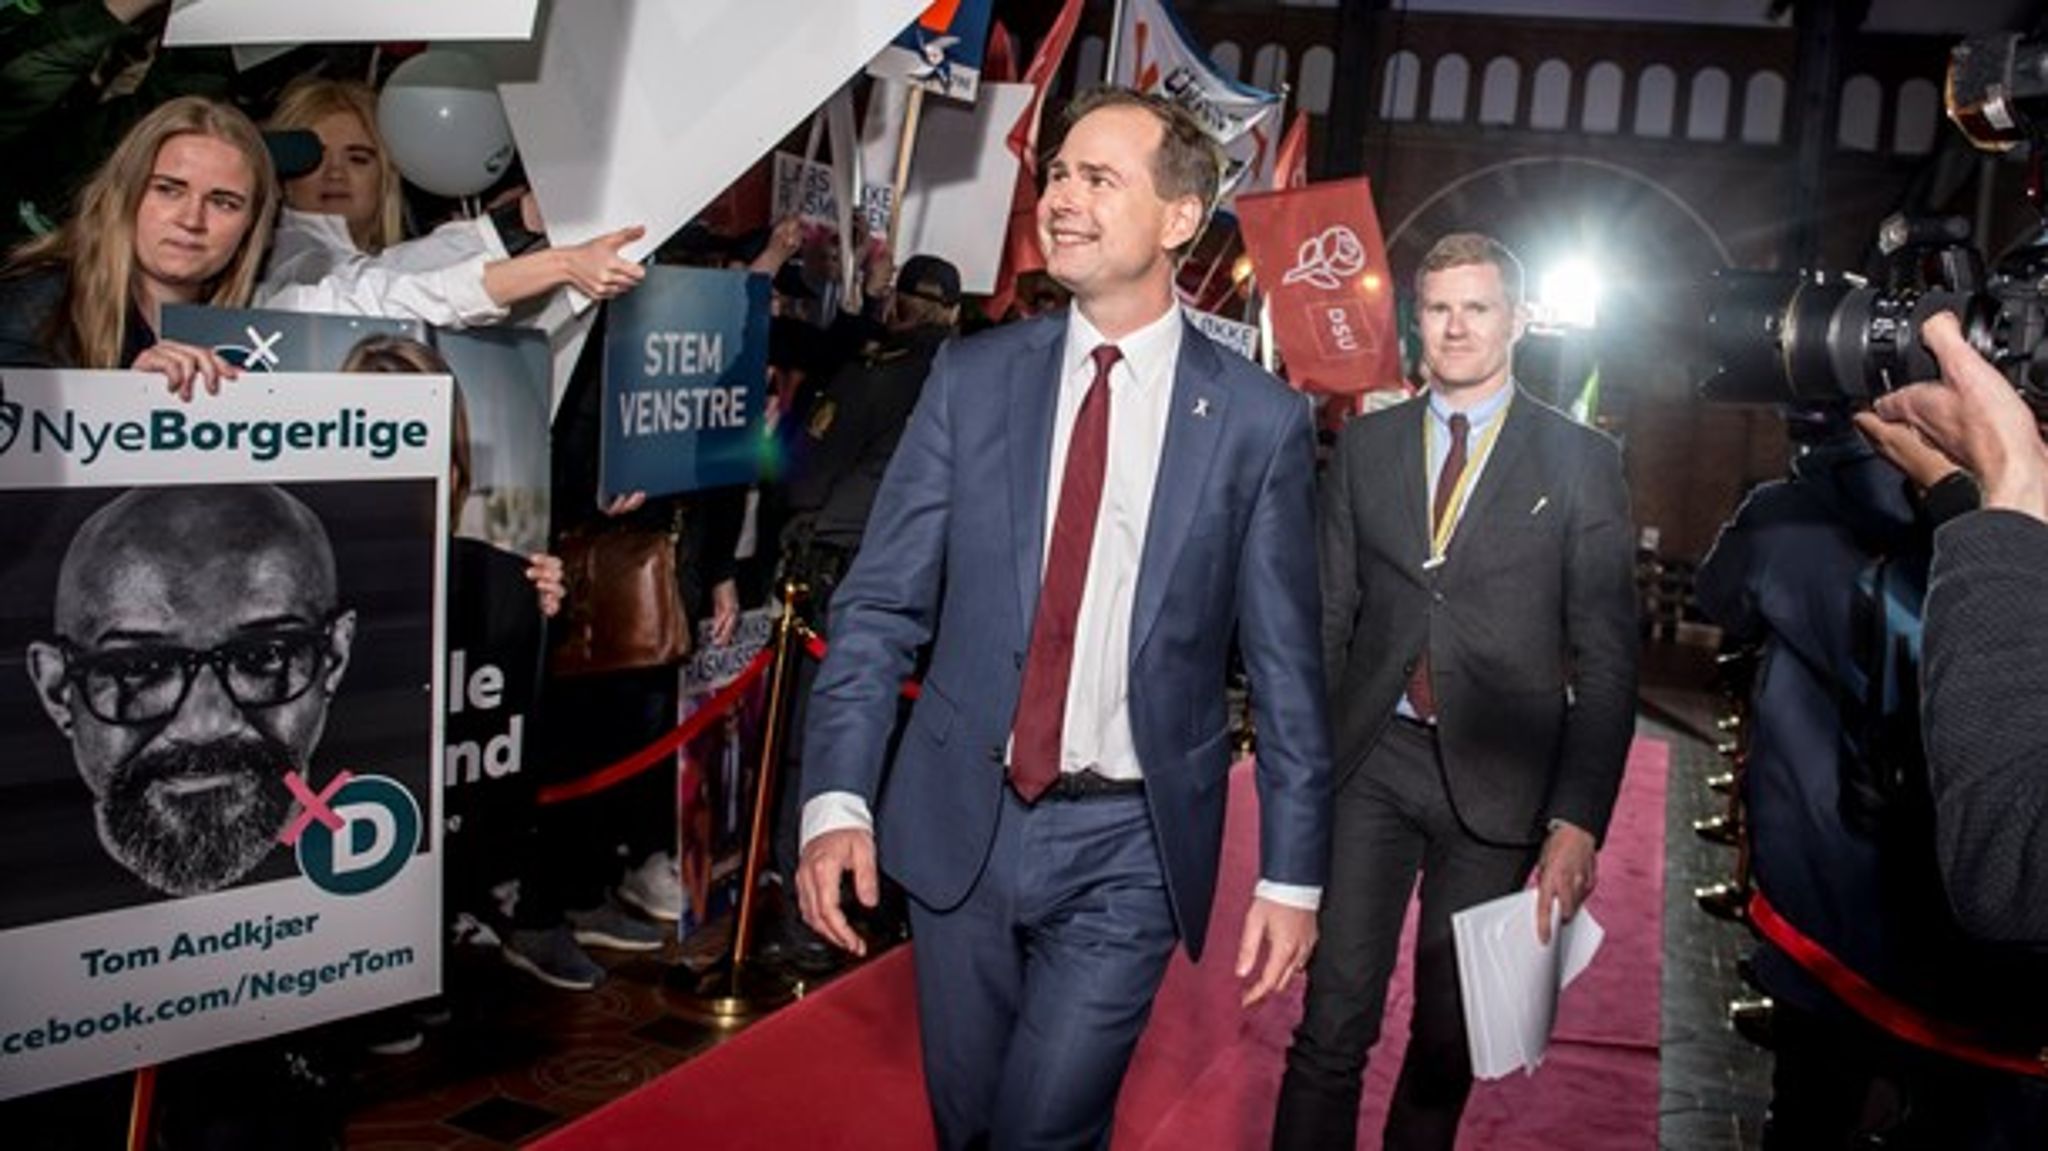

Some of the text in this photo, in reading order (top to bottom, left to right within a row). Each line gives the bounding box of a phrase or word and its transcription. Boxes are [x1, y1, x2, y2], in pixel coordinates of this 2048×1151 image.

[644, 331, 723, 376] STEM
[1327, 307, 1358, 350] DSU
[619, 385, 748, 438] VENSTRE
[332, 801, 397, 875] D
[81, 912, 320, 977] Tom Andkjær
[0, 945, 414, 1055] cebook.com/NegerTom
